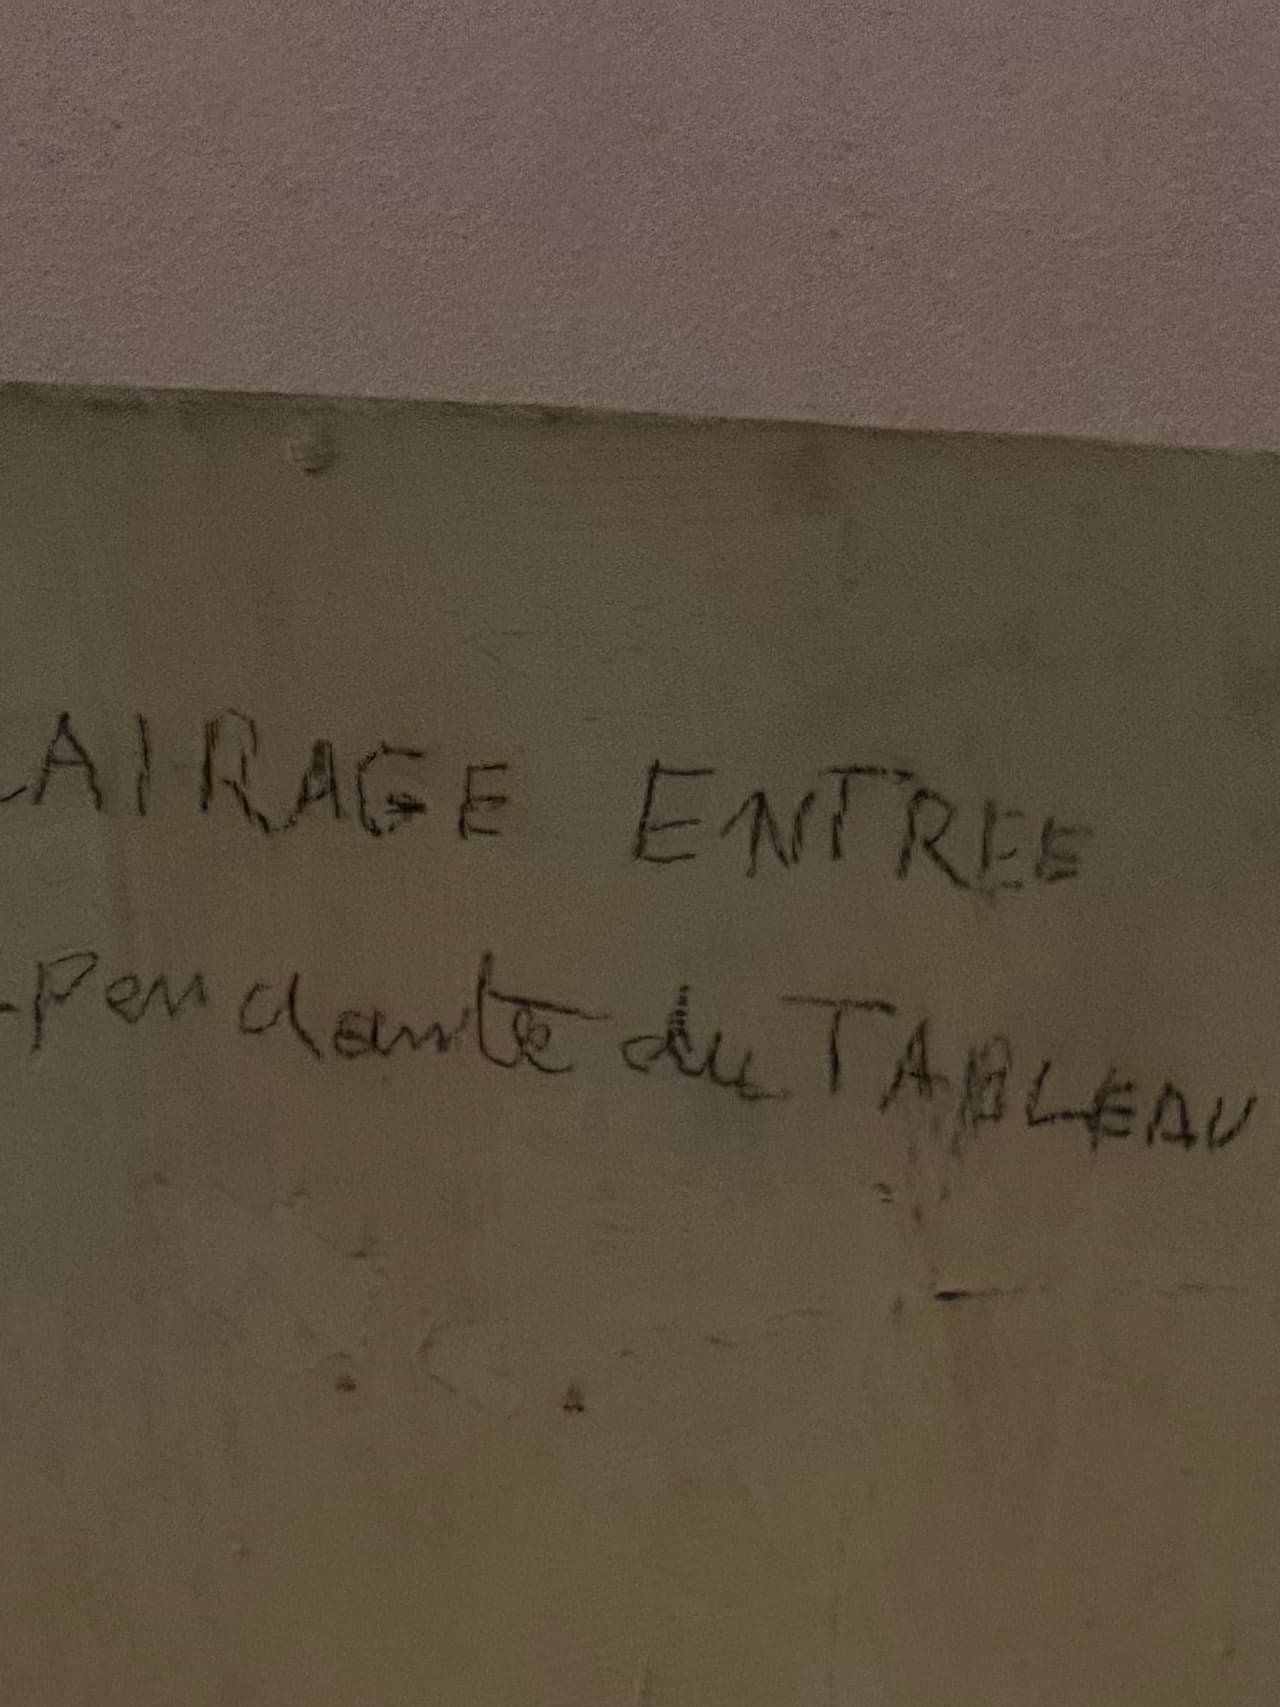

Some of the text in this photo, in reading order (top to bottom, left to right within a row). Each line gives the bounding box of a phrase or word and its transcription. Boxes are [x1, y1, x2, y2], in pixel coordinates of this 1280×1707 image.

[629, 760, 1098, 895] ENTREE
[619, 984, 792, 1105] du
[779, 989, 1260, 1156] TABLEAU
